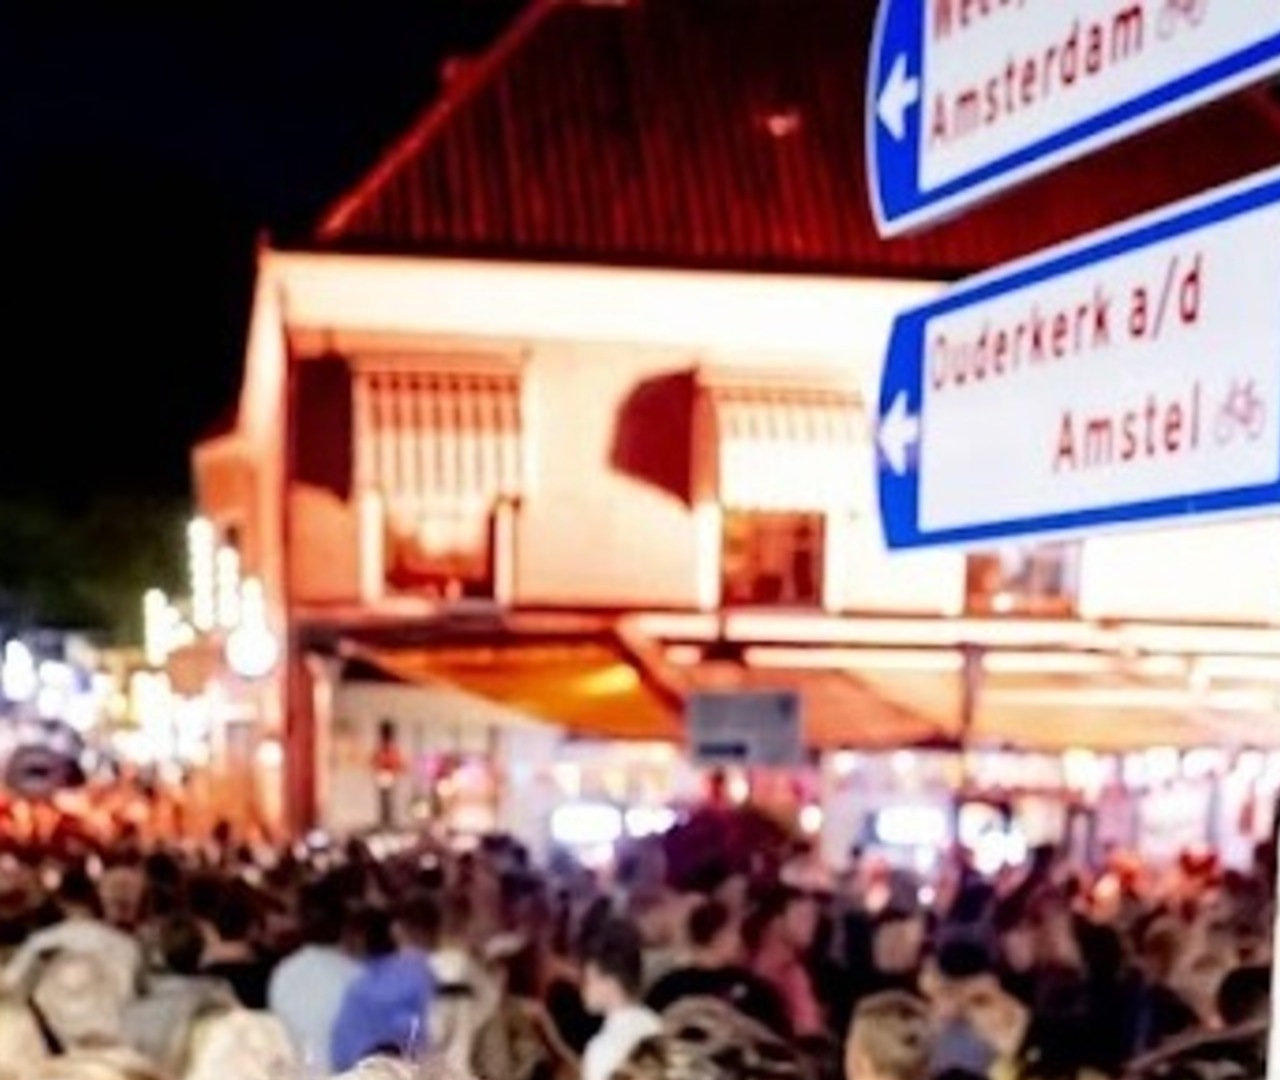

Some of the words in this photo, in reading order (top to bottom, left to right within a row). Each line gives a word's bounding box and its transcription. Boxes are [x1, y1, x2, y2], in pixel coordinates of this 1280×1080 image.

[932, 5, 1143, 143] Amsterdam
[931, 286, 1110, 390] Ouderkerk
[1128, 253, 1202, 340] a/d
[1053, 381, 1199, 472] Amstel
